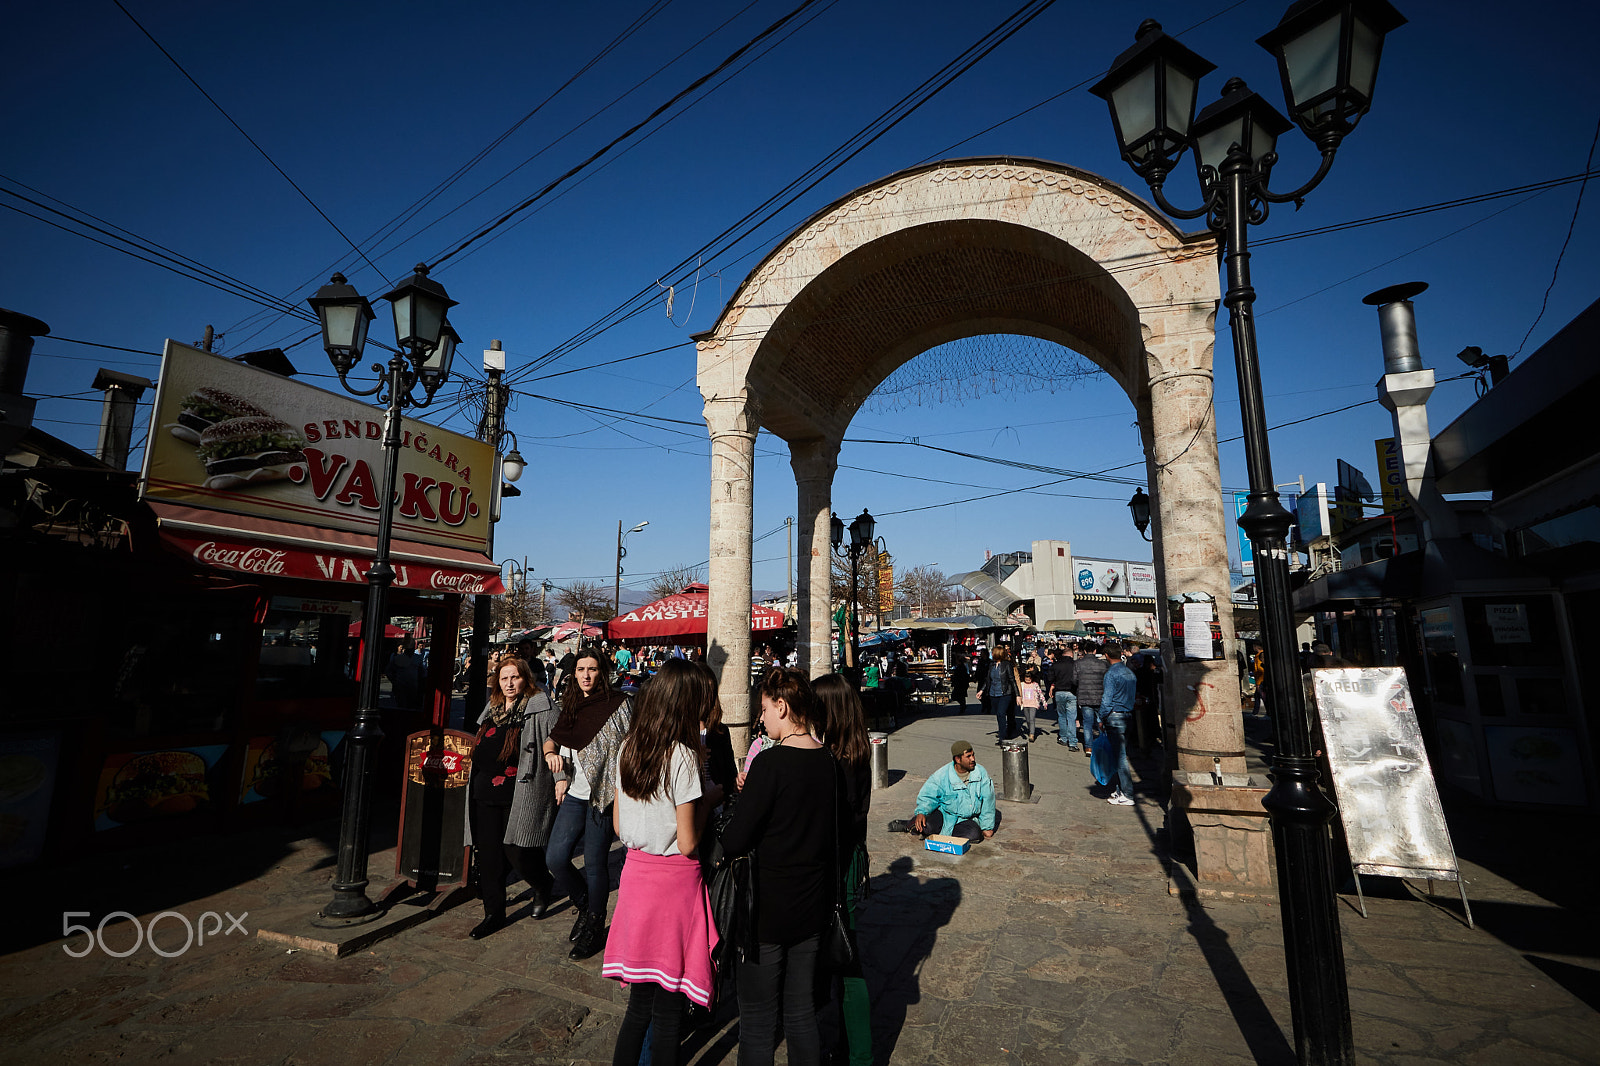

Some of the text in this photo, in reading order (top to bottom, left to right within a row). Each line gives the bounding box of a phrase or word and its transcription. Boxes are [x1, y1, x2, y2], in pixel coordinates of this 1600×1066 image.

[303, 419, 472, 484] SENDIČARA
[192, 541, 288, 574] Coca-Cola
[314, 553, 408, 587] VA-U
[430, 569, 485, 593] Coca-Cola
[621, 609, 706, 622] AMSTE
[423, 755, 458, 771] Coca-Cola
